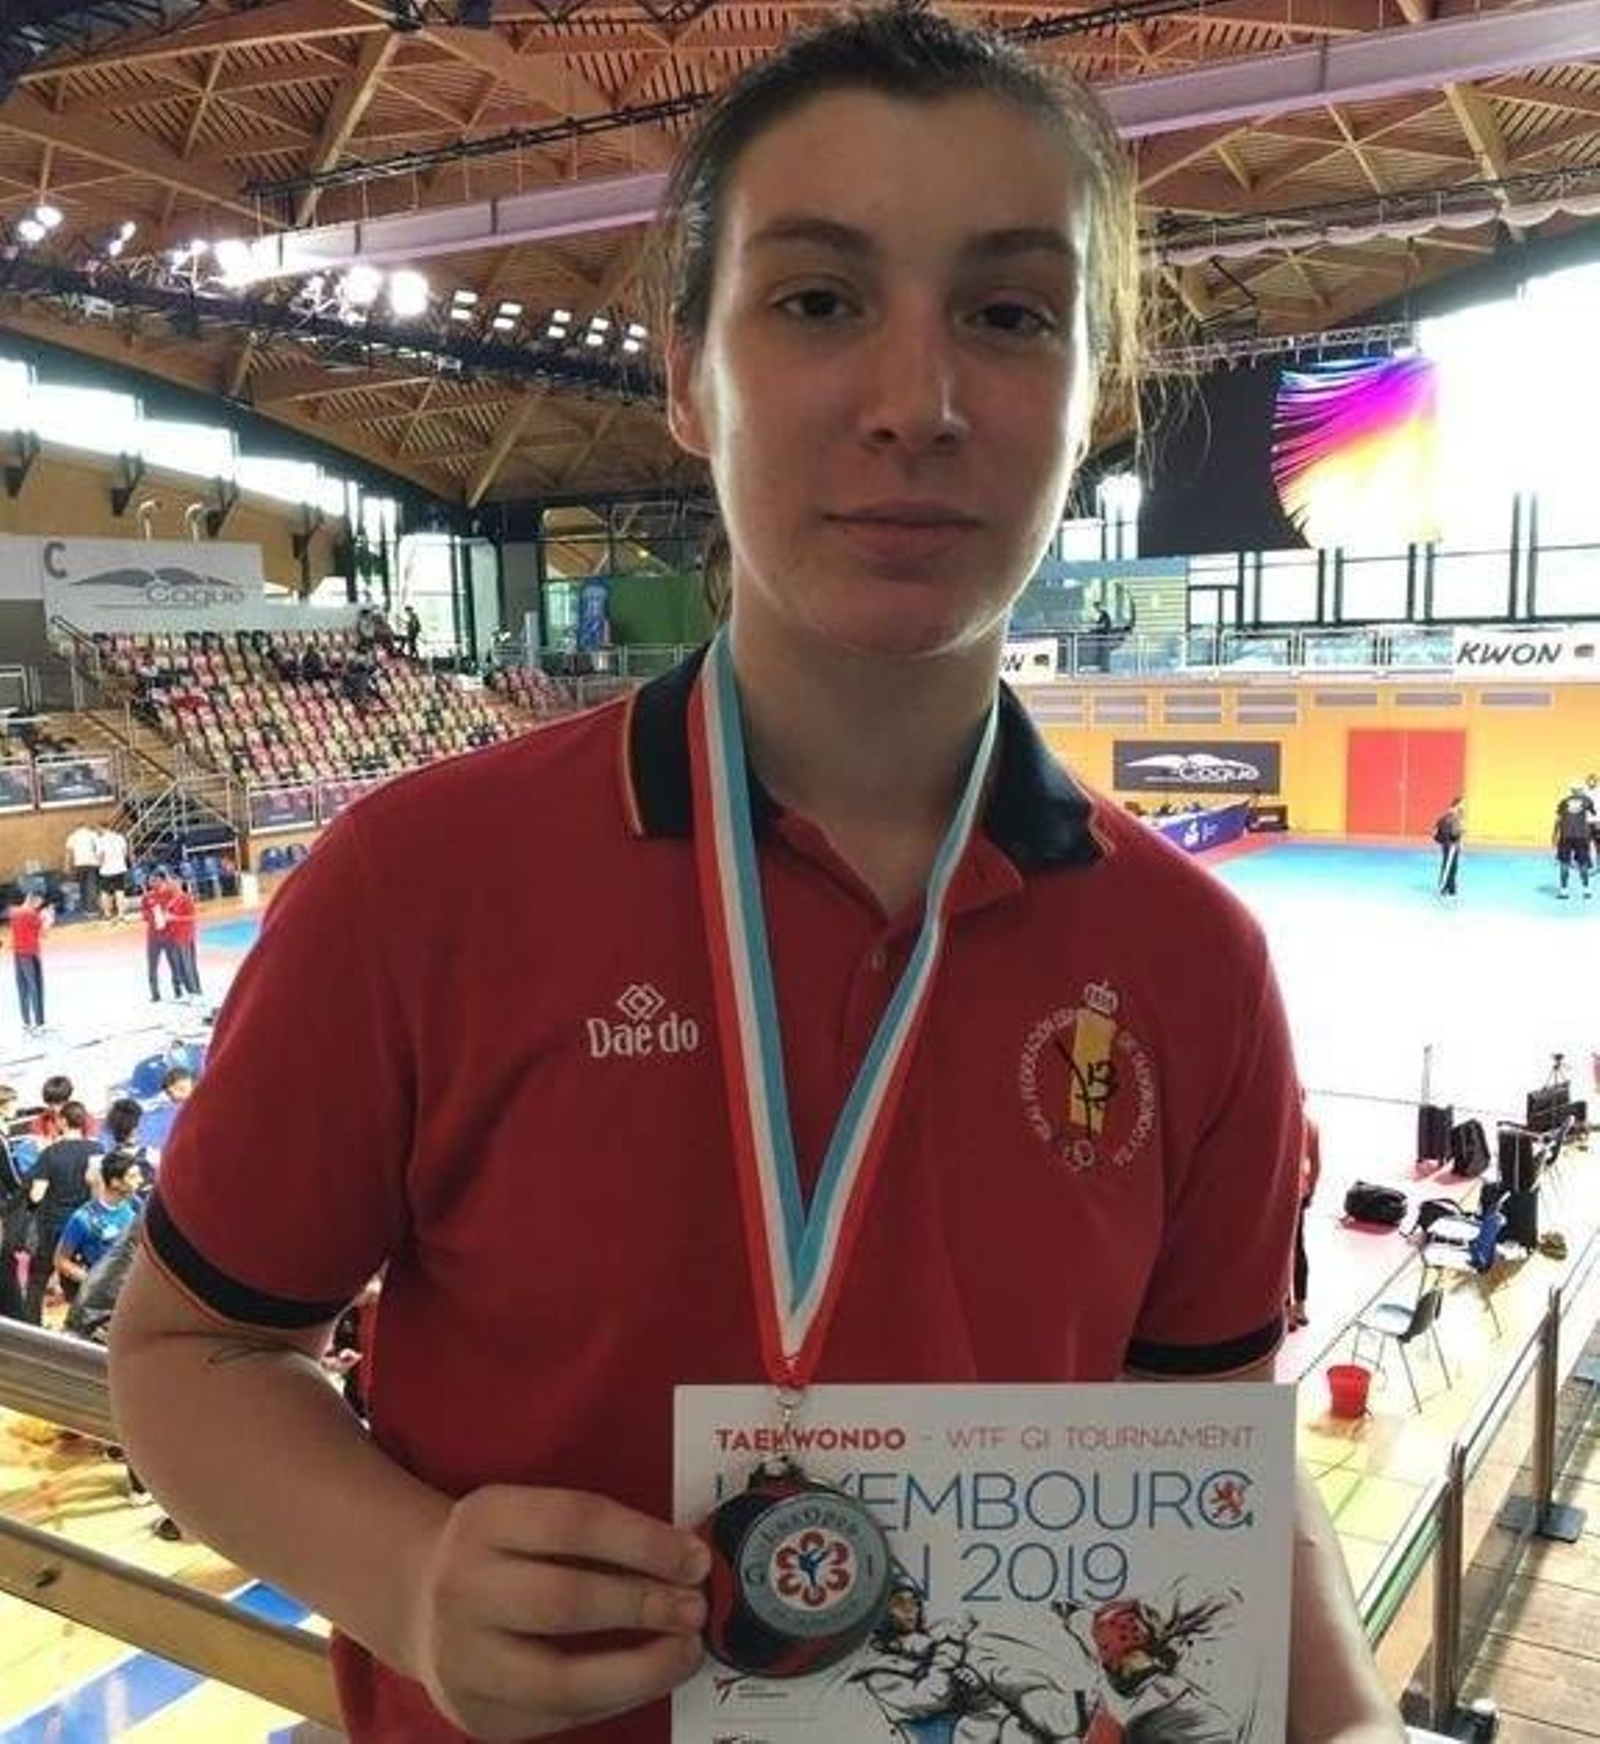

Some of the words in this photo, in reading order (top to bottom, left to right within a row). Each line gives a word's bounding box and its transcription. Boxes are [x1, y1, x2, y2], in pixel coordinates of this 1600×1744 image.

[43, 541, 67, 579] C
[1456, 642, 1562, 666] KWON
[716, 1428, 906, 1451] TAEKWONDO
[947, 1426, 1006, 1449] WTF
[1065, 1424, 1255, 1449] TOURNAMENT
[716, 1469, 1255, 1531] EMBOURG
[960, 1541, 1129, 1603] 2019
